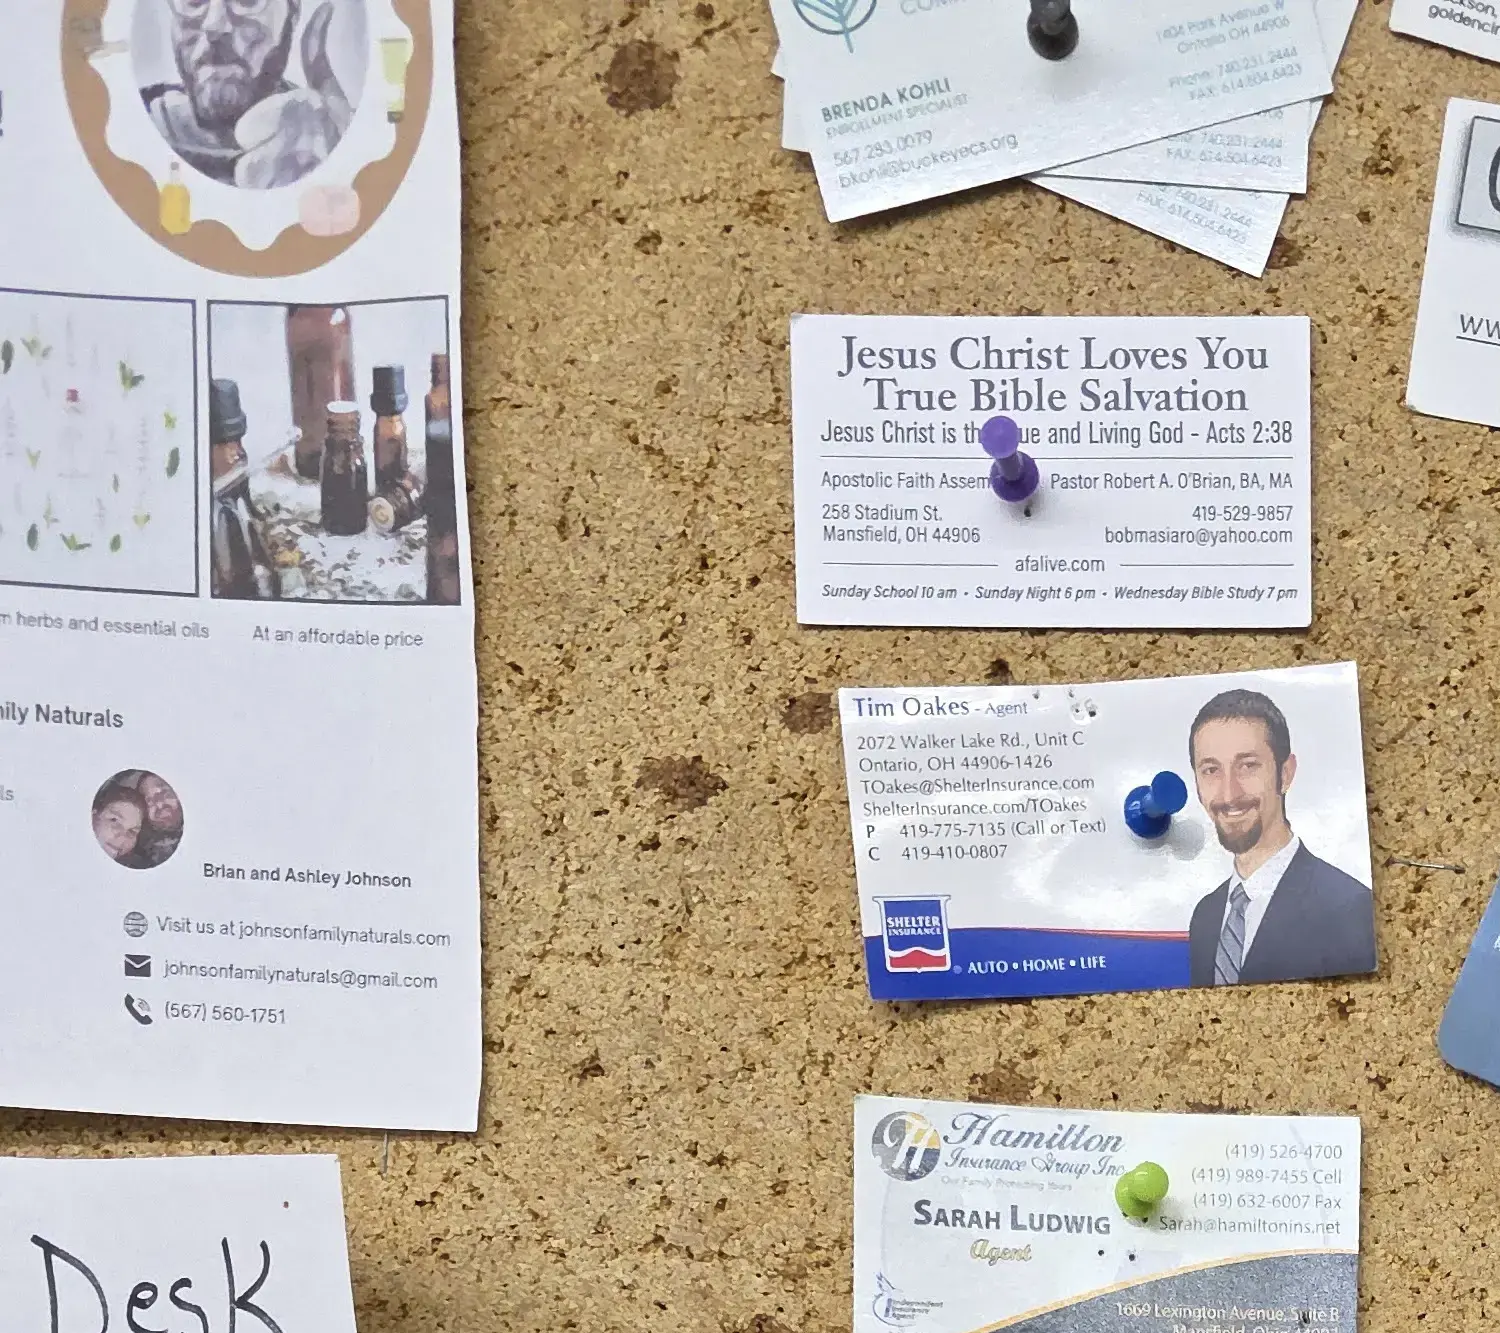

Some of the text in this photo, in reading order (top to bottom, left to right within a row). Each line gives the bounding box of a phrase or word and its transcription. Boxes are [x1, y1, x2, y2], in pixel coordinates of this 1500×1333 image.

[821, 77, 952, 124] BRENDA KOHLI
[837, 337, 1269, 377] Jesus Christ Loves You
[864, 378, 1248, 413] True Bible Salvation
[1050, 473, 1099, 489] Pastor
[1103, 473, 1155, 490] Robert
[1159, 474, 1173, 490] A.
[1240, 474, 1264, 492] BA,
[1269, 474, 1293, 490] MA
[1192, 505, 1293, 521] 419-529-9857
[823, 526, 981, 545] Mansfield, OH 44906
[1105, 528, 1293, 547] bobmasiaro@yahoo.com
[1015, 555, 1105, 572] afalive.com
[35, 704, 124, 729] Naturals
[852, 698, 969, 717] Tim Oakes
[857, 731, 1084, 750] 2072 Walker Lake Rd., Unit C
[859, 754, 1052, 774] Ontario, OH 44906-1426
[899, 821, 1005, 839] 419-775-7135
[203, 864, 411, 889] Brian and Ashley Johnson
[156, 916, 450, 946] Visit us at johnsonfamilynaturals.com
[968, 955, 1106, 974] AUTO HOME LIFE
[162, 960, 438, 990] johnsonfamilynaturals@gmail.com
[164, 1001, 285, 1024] (567) 560-1751
[943, 1112, 1124, 1153] Hamilton
